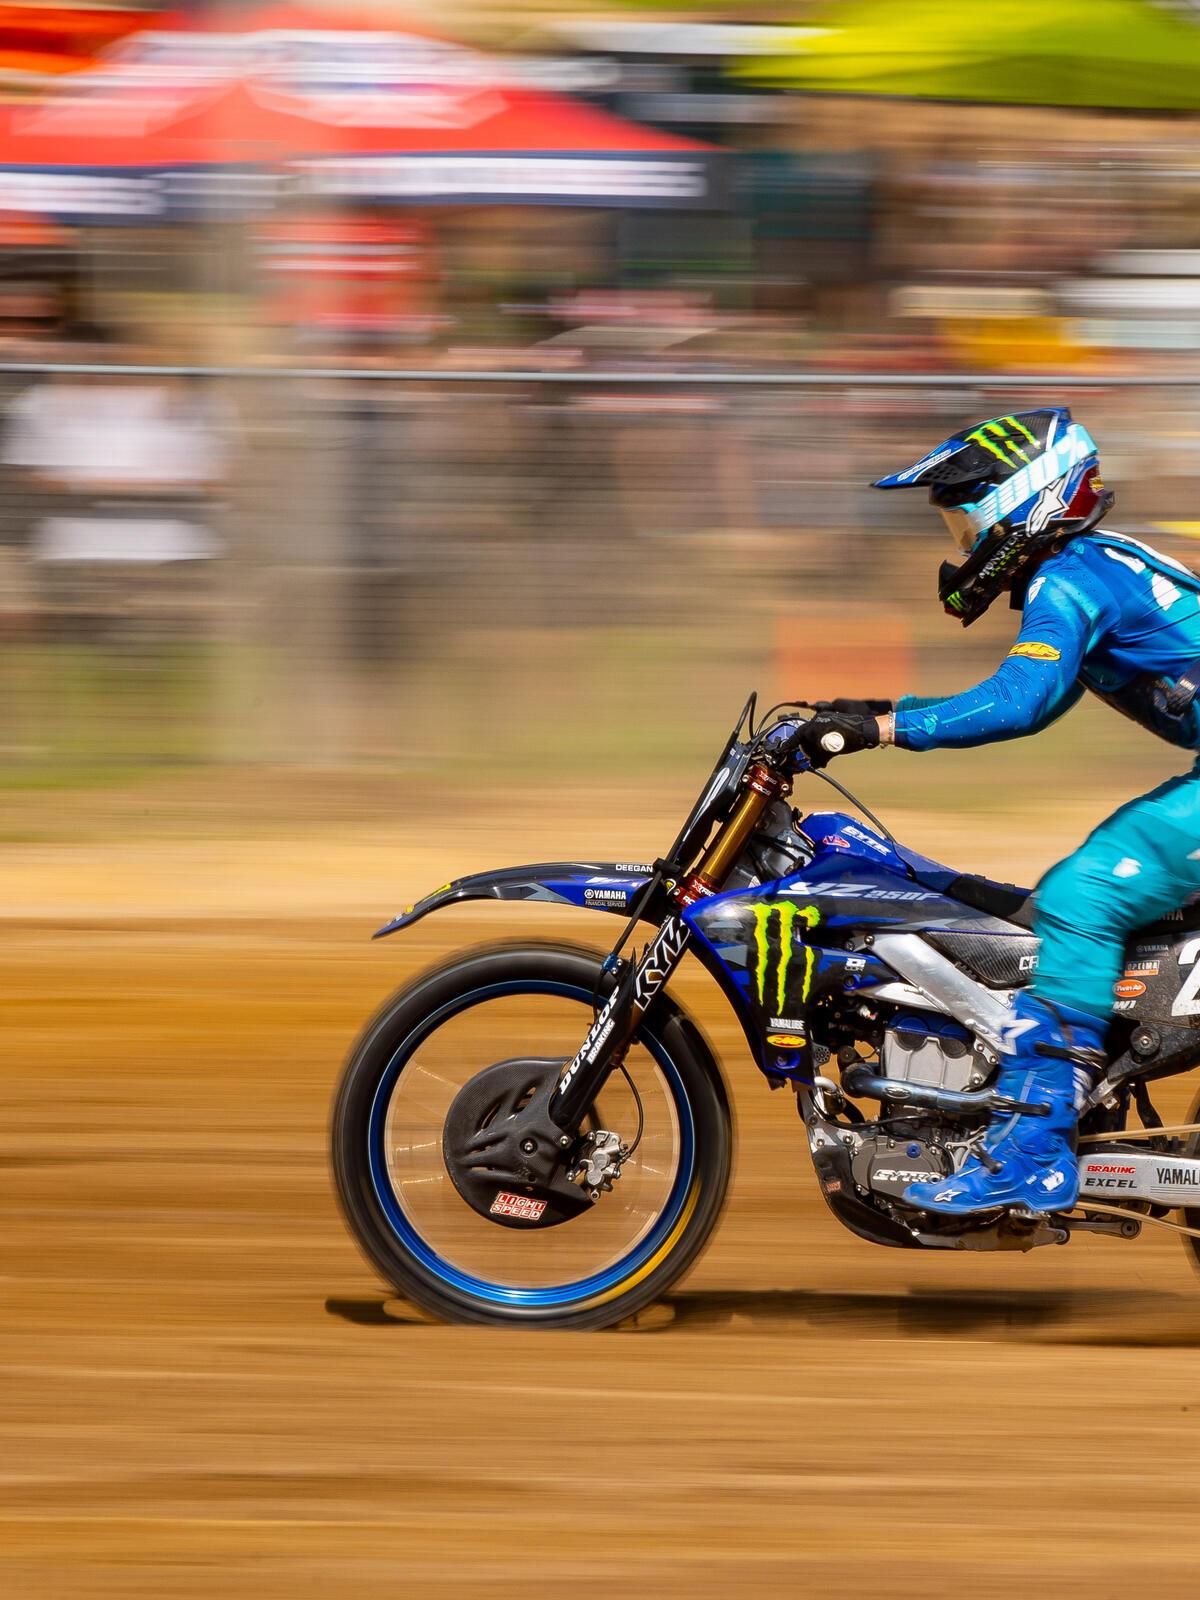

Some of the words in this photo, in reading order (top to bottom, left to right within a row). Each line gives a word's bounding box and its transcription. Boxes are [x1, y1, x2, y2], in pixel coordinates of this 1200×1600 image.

[615, 863, 654, 873] DEEGAN
[594, 888, 627, 900] YAMAHA
[1127, 962, 1158, 971] OPTIMA
[559, 985, 620, 1096] DUNLOP
[586, 1018, 616, 1065] BRAKING
[1086, 1165, 1137, 1174] BRAKING
[1084, 1177, 1138, 1189] EXCEL
[497, 1193, 547, 1212] LIGHT
[490, 1203, 542, 1220] SPEED
